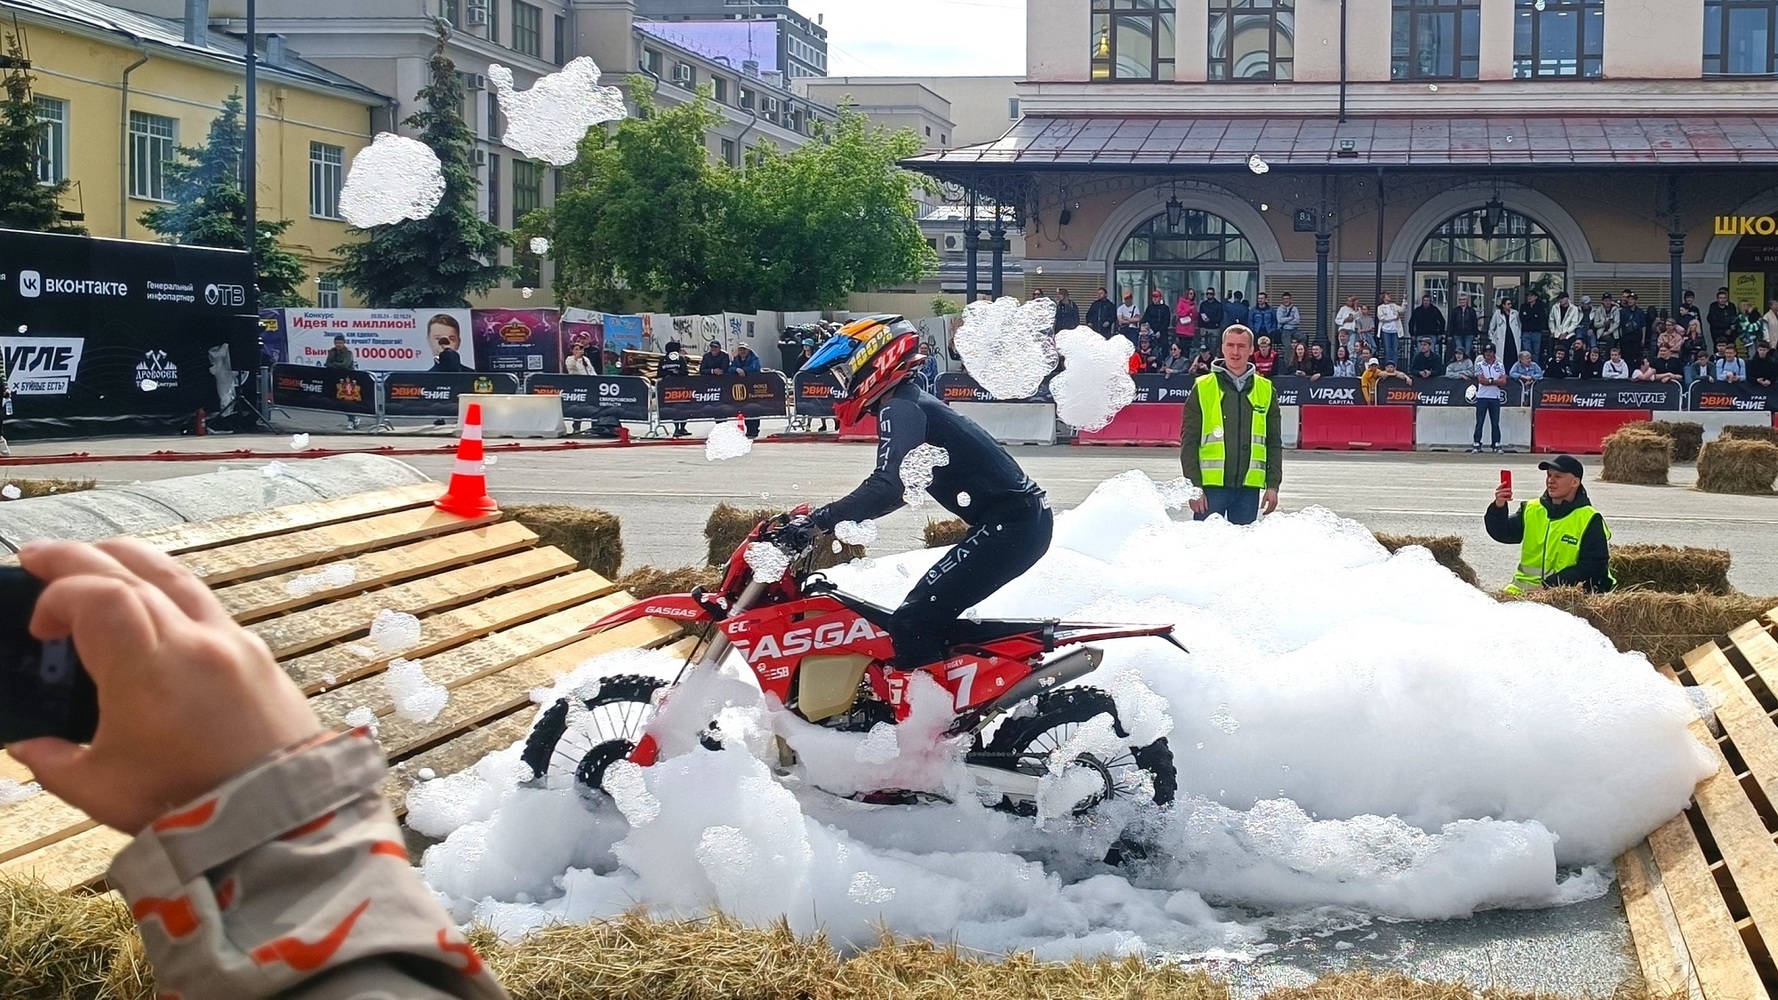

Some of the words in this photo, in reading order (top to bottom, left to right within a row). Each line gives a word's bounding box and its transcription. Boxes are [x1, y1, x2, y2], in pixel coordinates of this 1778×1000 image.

[146, 280, 194, 292] Генеральный
[204, 283, 245, 306] ОТВ
[292, 316, 328, 330] Идея
[331, 320, 348, 328] на
[352, 317, 417, 329] миллион!
[848, 325, 893, 373] 100%
[47, 381, 66, 391] ЕСТЬ?
[599, 383, 620, 396] 90
[1309, 387, 1356, 400] VIRAX
[644, 605, 698, 618] GASGAS
[731, 617, 890, 664] ASGA
[947, 661, 977, 710] 7
